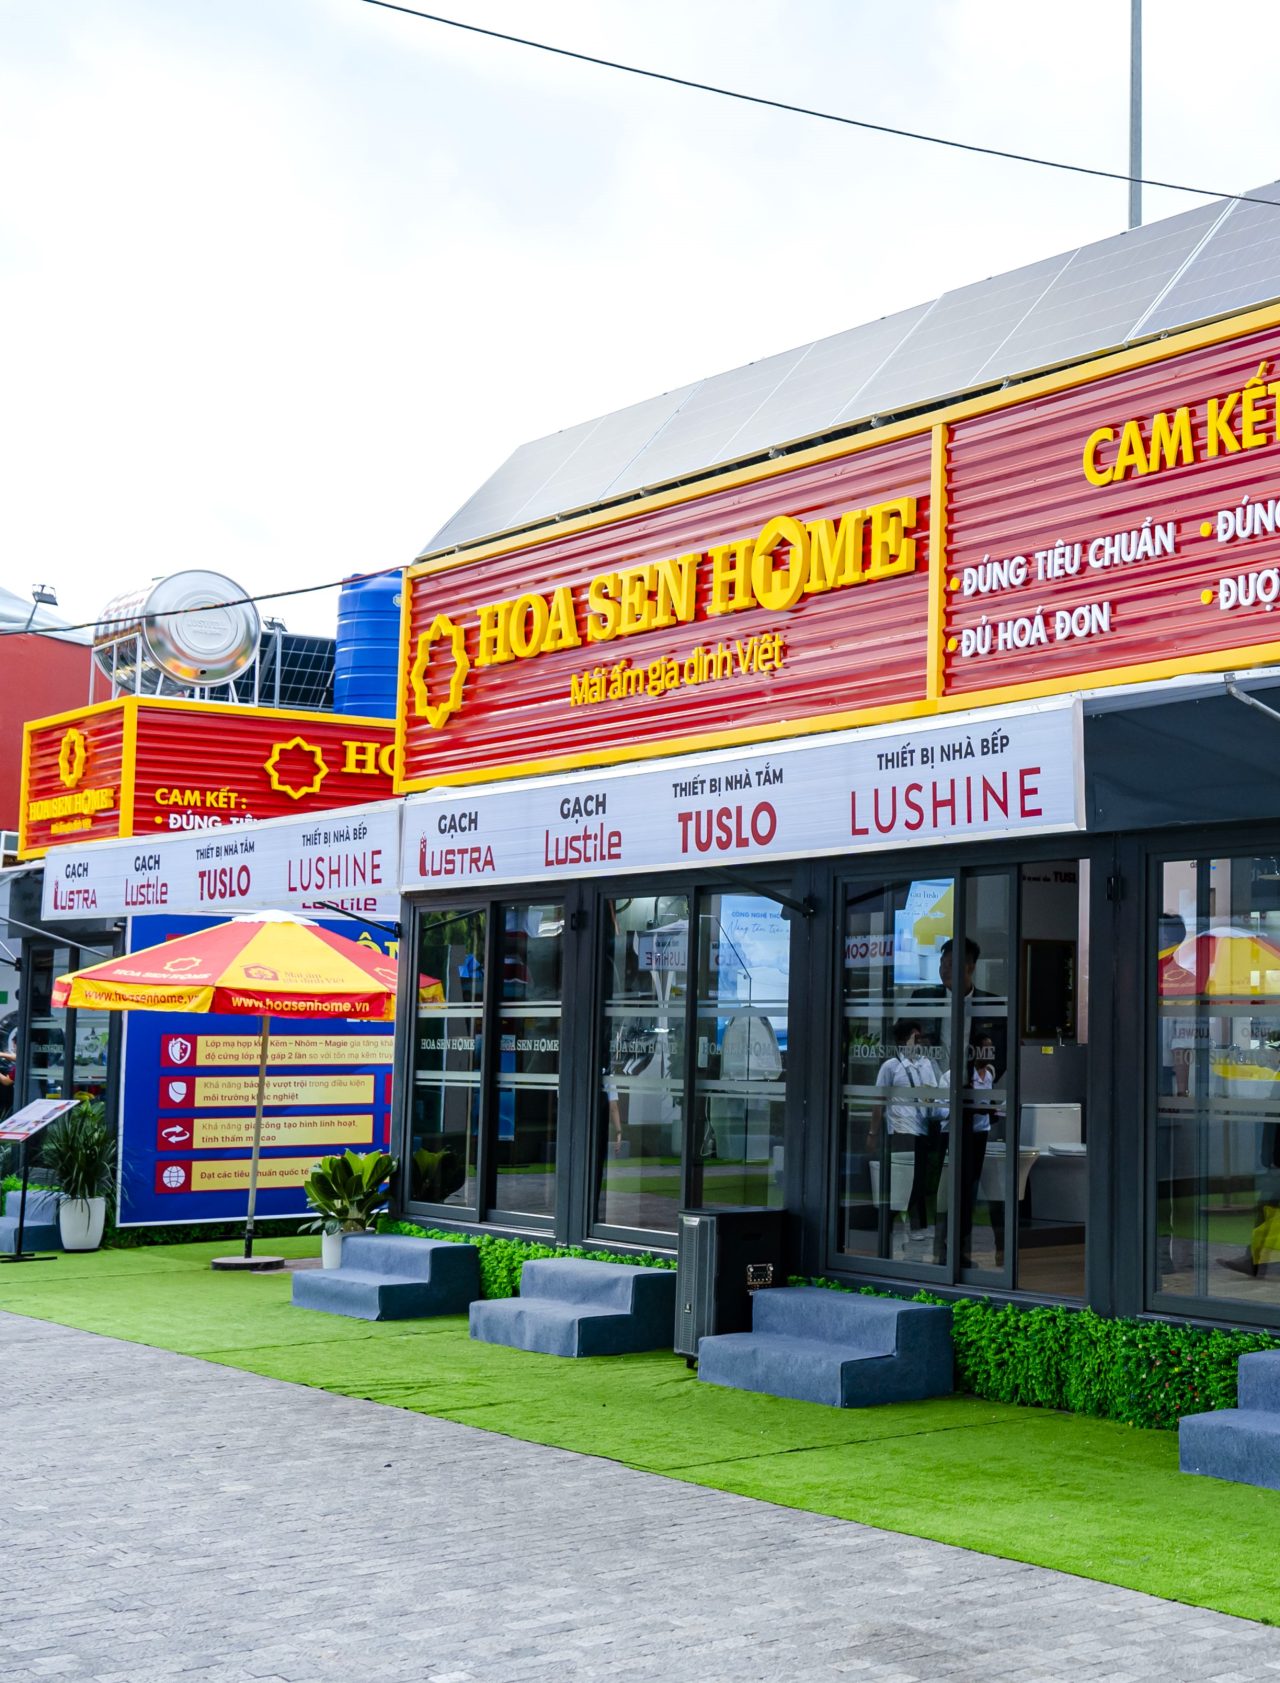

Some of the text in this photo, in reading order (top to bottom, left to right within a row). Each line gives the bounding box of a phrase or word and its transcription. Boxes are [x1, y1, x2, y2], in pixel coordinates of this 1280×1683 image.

[1082, 405, 1196, 487] CAM
[962, 515, 1175, 597] ĐÚNG TIÊU CHUẨN
[474, 497, 917, 667] HOA SEN HOME
[960, 601, 1111, 658] ĐỦ HOÁ ĐƠN
[570, 632, 785, 707] Mái ấm gia đình Việt
[437, 728, 1010, 838] GẠCH GẠCH THIẾT BỊ NHÀ TẮM THIẾT BỊ NHÀ BẾP
[155, 788, 200, 806] CAM
[168, 810, 222, 830] ĐÚNG
[419, 766, 1042, 876] LUSTRA Lustile TUSLO LUSHINE
[65, 822, 367, 882] GẠCH GẠCH THIẾT BỊ NHÀ TẮM THIẾT BỊ NHÀ BẾP
[53, 849, 382, 911] LUSTRA Lustile TUSLO LUSHINE
[231, 996, 370, 1013] www.hoasenhome.vn
[205, 1040, 221, 1049] Lớp
[237, 1040, 251, 1049] hợp
[324, 1040, 348, 1048] Magie
[421, 1038, 475, 1051] HOA SEN HOME
[517, 1039, 559, 1053] SEN HOME
[853, 1045, 877, 1058] HOA
[205, 1052, 217, 1061] độ
[241, 1052, 255, 1061] lớp
[273, 1080, 292, 1089] vượt
[260, 1121, 281, 1130] công
[283, 1122, 298, 1130] tạo
[200, 1171, 215, 1180] Đạt
[217, 1170, 233, 1179] các
[256, 1168, 277, 1177] huẩn
